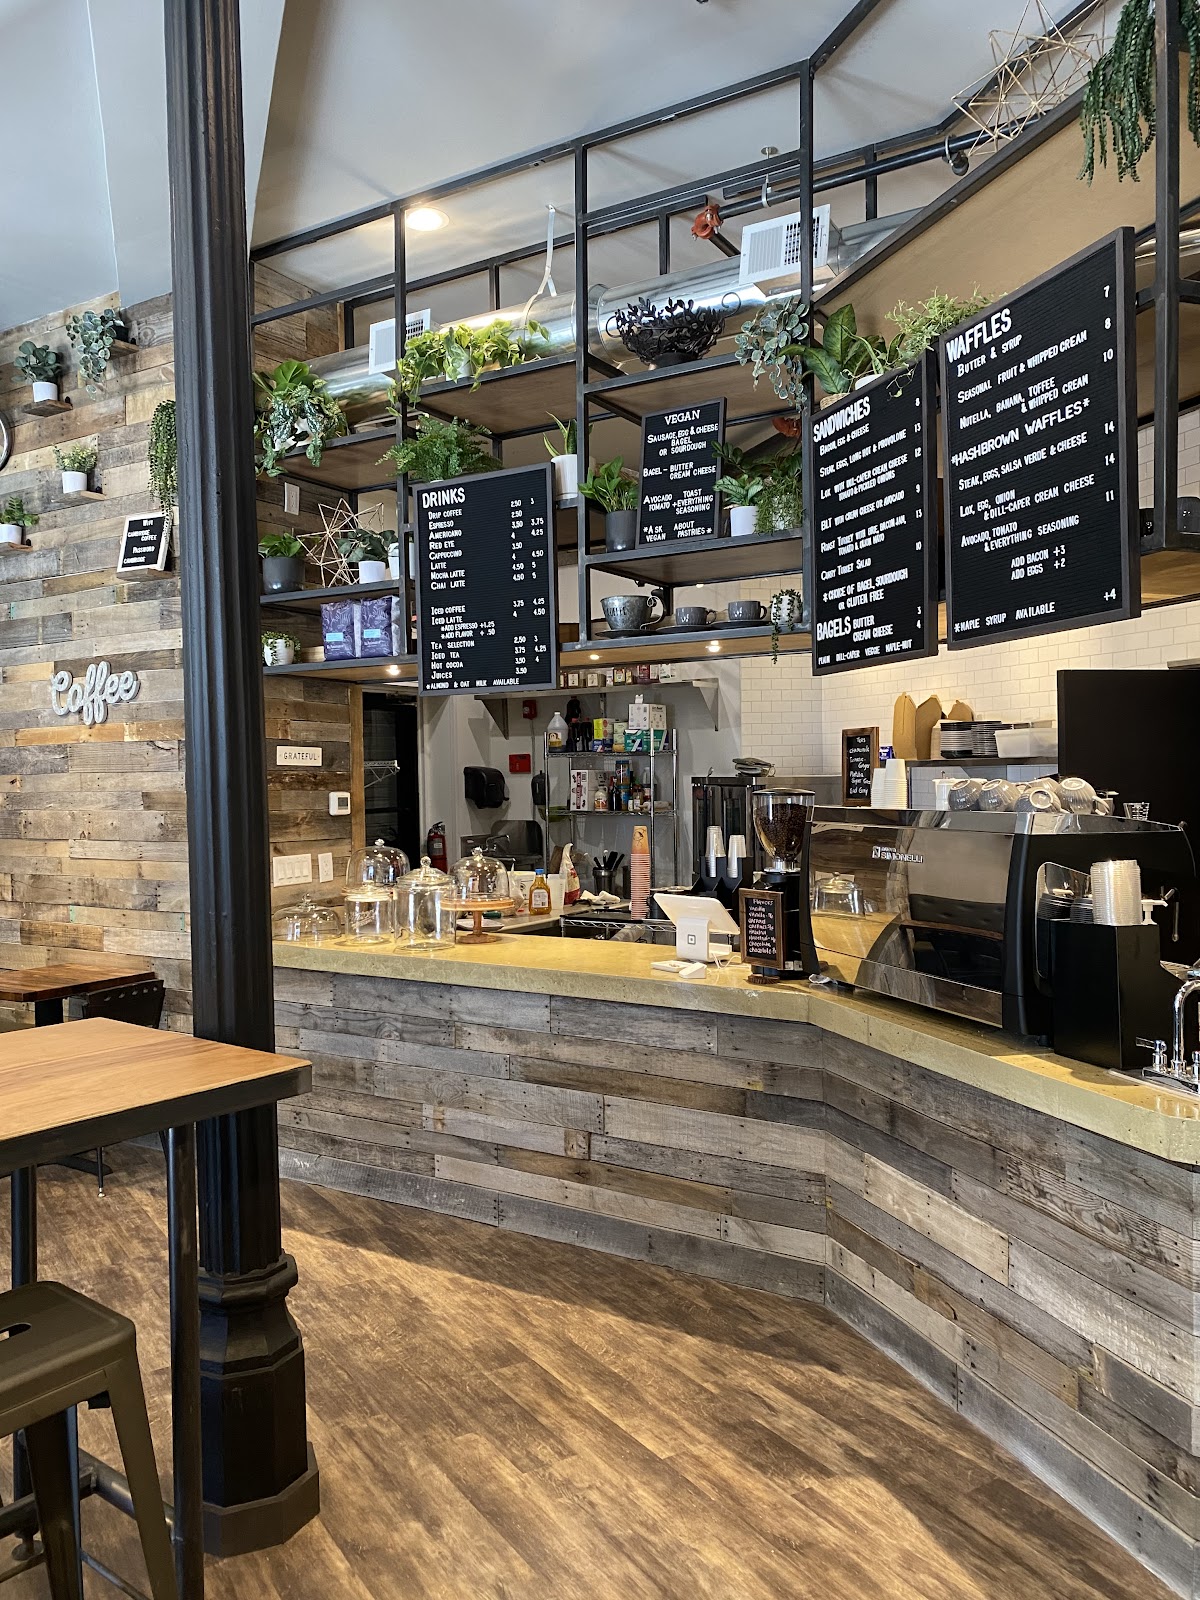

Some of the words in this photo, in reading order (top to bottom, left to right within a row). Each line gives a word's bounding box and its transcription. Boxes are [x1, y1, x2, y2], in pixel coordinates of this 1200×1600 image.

[946, 308, 1012, 363] WAFFLES
[957, 354, 986, 377] BUTTER
[990, 346, 997, 360] &
[1002, 335, 1023, 353] SYRUP
[1104, 285, 1110, 298] 7
[957, 380, 992, 403] SEASONAL
[998, 365, 1018, 384] FRUIT
[1019, 363, 1026, 373] &
[1027, 345, 1059, 369] WHIPPED
[1059, 330, 1087, 353] CREAM
[1104, 317, 1111, 329] 8
[1028, 377, 1056, 397] TOFFEE
[1103, 349, 1113, 362] 10
[1021, 403, 1027, 413] &
[1028, 388, 1058, 410] WHIPPED
[1062, 374, 1089, 394] CREAM
[664, 410, 700, 425] VEGAN
[813, 396, 871, 443] SANDWICHES
[690, 426, 696, 436] &
[696, 423, 718, 434] CHEESE
[851, 423, 870, 440] CHEESE
[659, 448, 667, 456] OR
[671, 441, 707, 455] SOURDOUGH
[671, 436, 692, 447] BAGEL
[1001, 458, 1022, 474] SALSA
[1024, 447, 1047, 465] VERDE
[1050, 445, 1057, 456] &
[1057, 432, 1088, 453] CHEESE
[1104, 421, 1115, 435] 14
[888, 454, 908, 469] CHEESE
[643, 467, 662, 477] BAGEL
[670, 462, 693, 472] BUTTER
[670, 470, 690, 480] CREAM
[693, 465, 716, 476] CHEESE
[995, 489, 1016, 505] ONION
[1104, 453, 1115, 466] 14
[422, 487, 465, 508] DRINKS
[643, 494, 672, 505] AVOCADO
[683, 489, 702, 498] TOAST
[984, 510, 990, 521] &
[990, 497, 1030, 519] DILL-CAPER
[1034, 486, 1059, 504] CREAM
[1064, 474, 1095, 493] CHEESE
[443, 509, 462, 518] COFFEE
[648, 501, 670, 511] TOMATO
[676, 503, 710, 515] SEASONING
[821, 518, 832, 531] BLT
[875, 499, 883, 509] OR
[992, 521, 1018, 538] TOMATO
[1105, 490, 1114, 502] 11
[531, 518, 544, 526] 3.75
[674, 521, 694, 531] ABOUT
[646, 533, 666, 542] VEGAN
[984, 541, 990, 552] &
[990, 529, 1032, 551] EVERYTHING
[1037, 515, 1079, 537] SEASONING
[429, 541, 442, 550] RED
[444, 540, 455, 548] EYE
[1011, 556, 1025, 568] ADD
[1026, 549, 1049, 564] BACON
[1053, 544, 1065, 557] +3
[431, 562, 446, 570] LATTE
[1011, 568, 1025, 580] ADD
[1027, 564, 1043, 577] EGGS
[1054, 558, 1066, 569] +2
[450, 570, 465, 578] LATTE
[846, 584, 855, 594] OF
[875, 568, 908, 587] SOURDOUGH
[450, 580, 465, 588] LATTE
[846, 594, 868, 608] GLUTEN
[869, 589, 885, 602] FREE
[445, 605, 465, 613] COFFEE
[986, 613, 1007, 626] SYRUP
[1015, 602, 1055, 620] AVAILABLE
[1104, 588, 1116, 601] +4
[446, 616, 463, 624] LATTE
[455, 630, 473, 638] FLAVOR
[817, 616, 851, 641] BAGELS
[853, 615, 875, 629] BUTTER
[853, 630, 871, 642] CREAM
[873, 624, 893, 638] CHEESE
[431, 642, 442, 650] TEA
[447, 640, 474, 649] SELECTION
[431, 652, 445, 660] ICED
[431, 671, 453, 680] JUICES
[493, 678, 520, 686] AVAILABLE
[51, 661, 140, 725] Coffee
[284, 752, 317, 760] GRATEFUL
[881, 852, 923, 863] SIMONELLI
